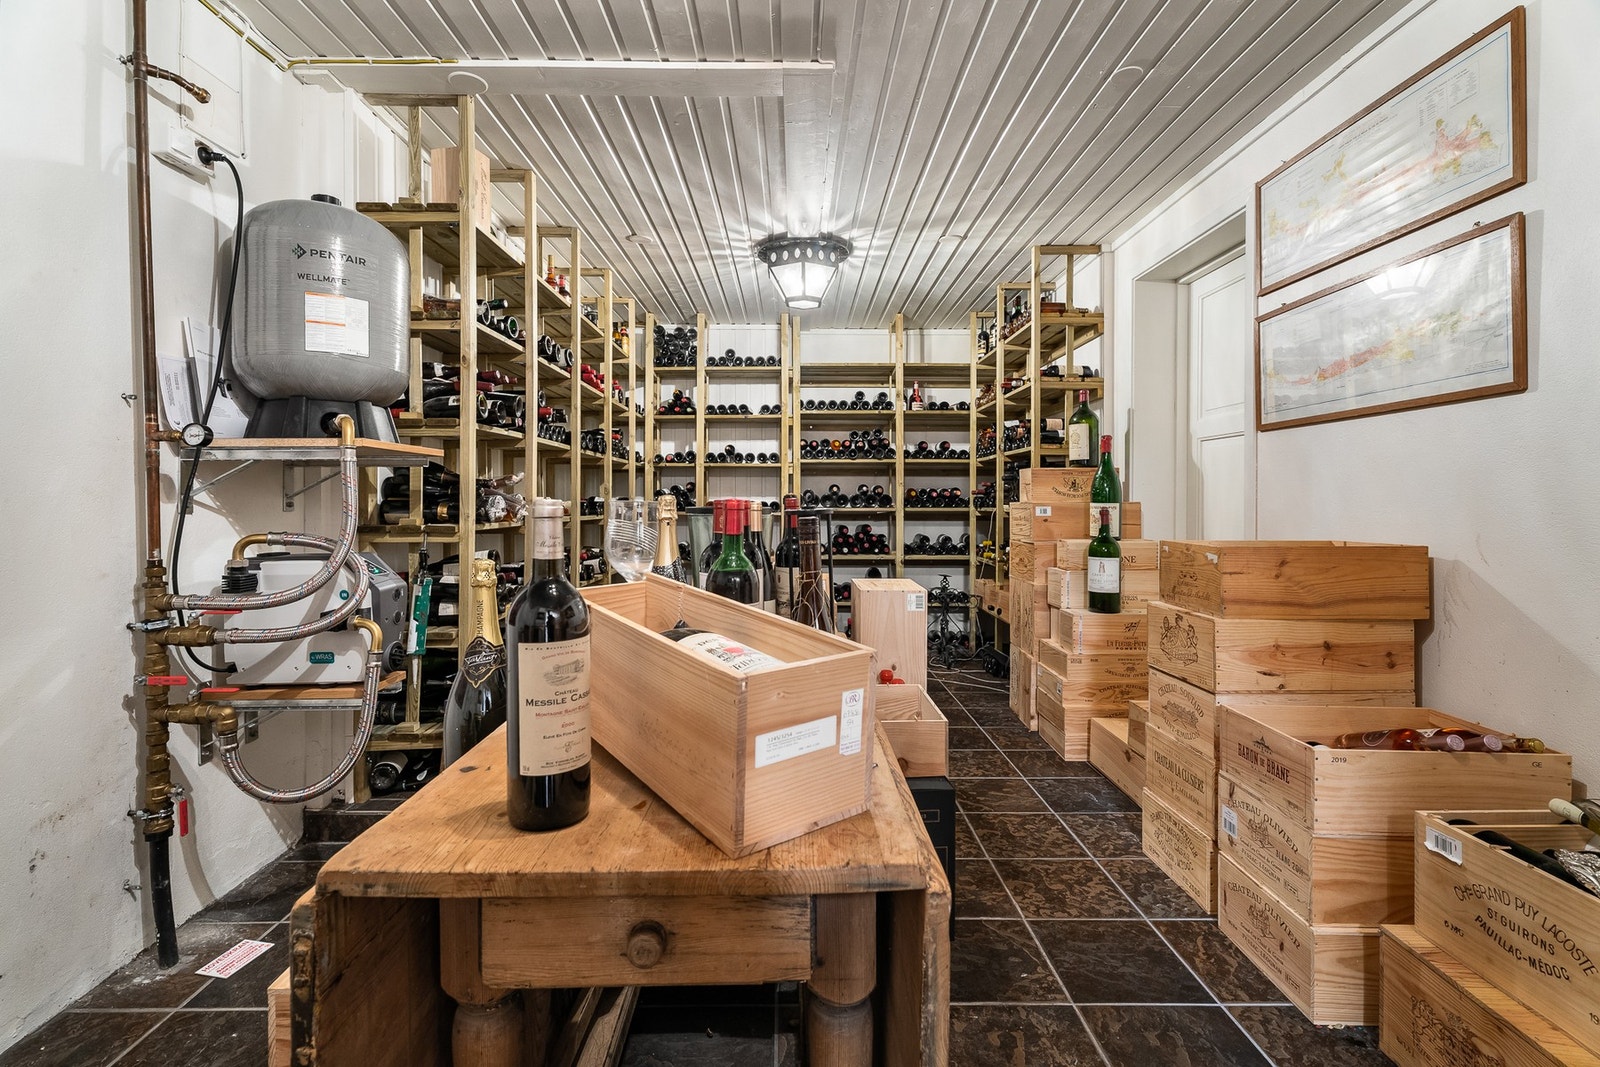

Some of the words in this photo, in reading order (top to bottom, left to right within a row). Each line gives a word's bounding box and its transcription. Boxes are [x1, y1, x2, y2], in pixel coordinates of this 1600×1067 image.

[310, 249, 367, 266] PENTAIR
[475, 599, 484, 637] HAMPAGNE
[525, 698, 568, 707] MESSILE
[1179, 686, 1205, 718] SOUTARD
[1154, 750, 1175, 775] CHATEAU
[1174, 763, 1182, 779] LA
[1237, 742, 1259, 766] BARON
[1266, 758, 1290, 785] BRANE
[1331, 756, 1348, 764] 2019
[1531, 761, 1543, 769] GE
[1263, 813, 1299, 855] OLIVIER
[1227, 881, 1263, 905] CHATEAU
[1264, 902, 1301, 950] OLIVIER
[1472, 883, 1511, 906] GRAND
[1515, 896, 1540, 921] PUY
[1541, 916, 1599, 977] LACOSTE
[1500, 914, 1556, 956] GUIRONS
